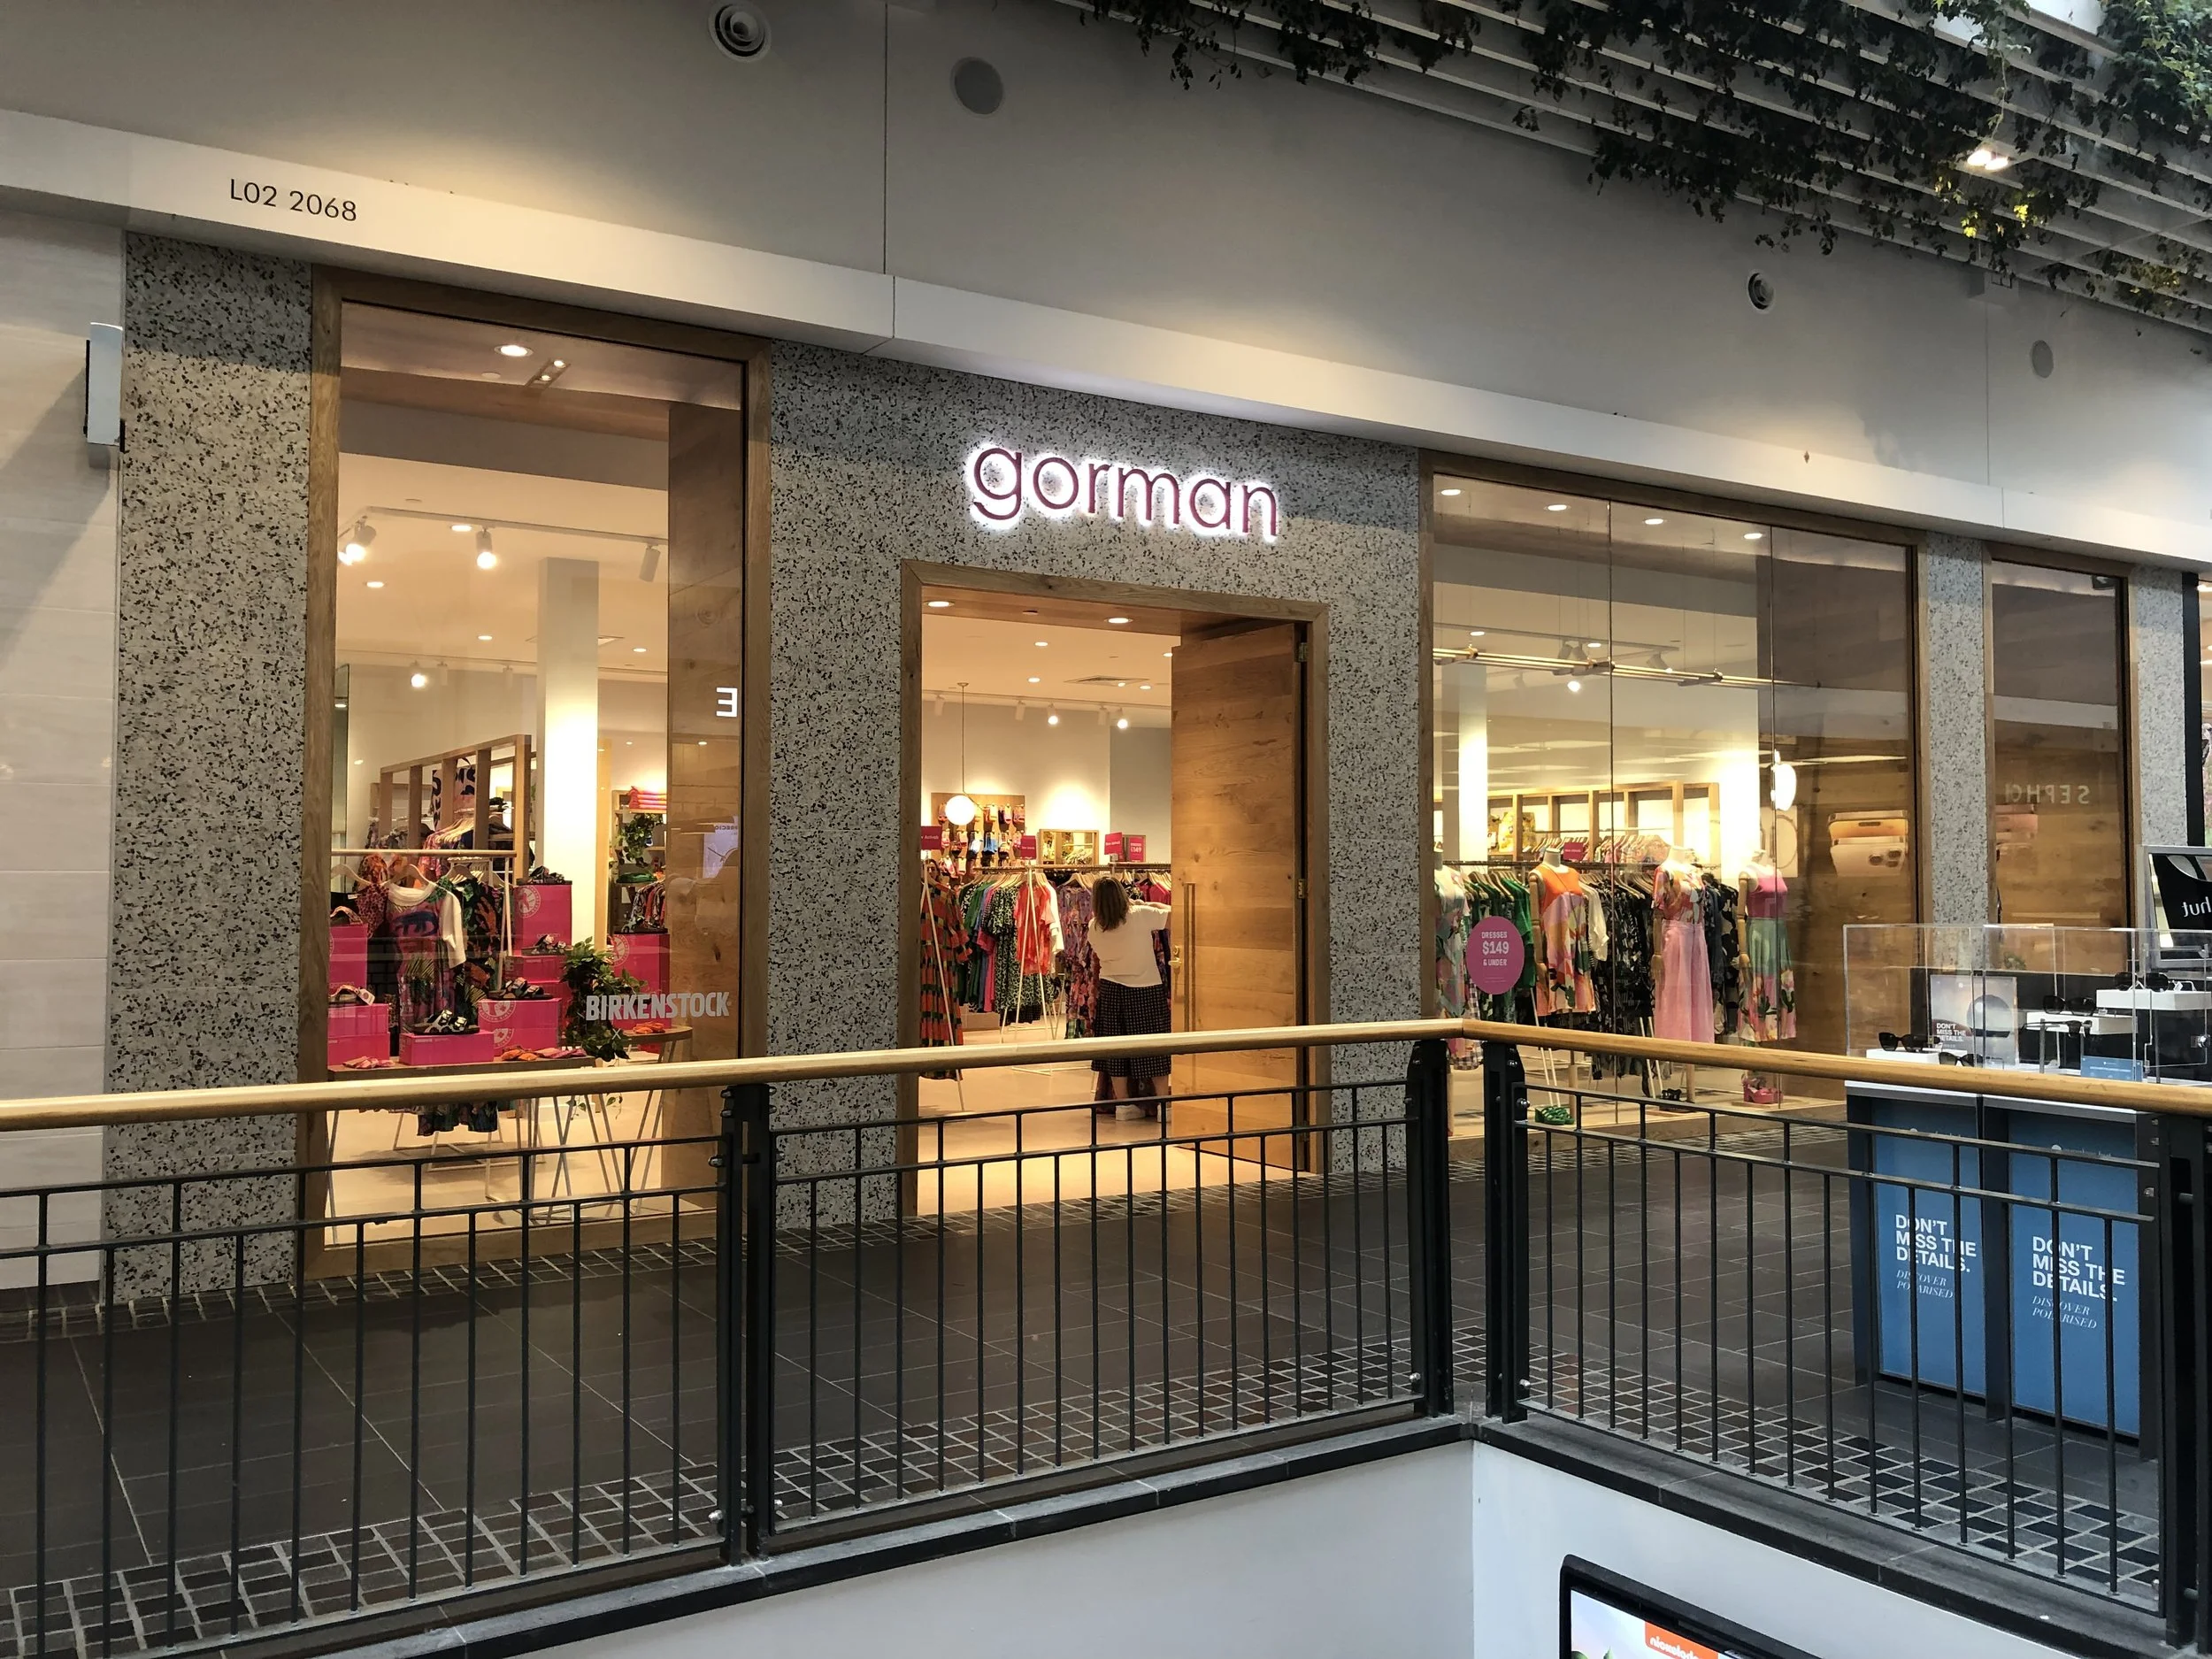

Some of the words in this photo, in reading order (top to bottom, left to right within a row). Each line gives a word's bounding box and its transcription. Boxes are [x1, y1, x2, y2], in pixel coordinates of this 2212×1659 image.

[230, 178, 277, 207] L02
[289, 190, 357, 221] 2068
[973, 447, 1276, 536] gorman
[1482, 941, 1509, 956] $149
[586, 992, 730, 1021] BIRKENSTOCK
[1896, 1230, 1938, 1250] MSS
[1896, 1269, 1947, 1286] DIOVER
[1896, 1280, 1954, 1298] POARISED
[2032, 1295, 2090, 1316] DISOVER
[2032, 1307, 2097, 1329] POLRISED
